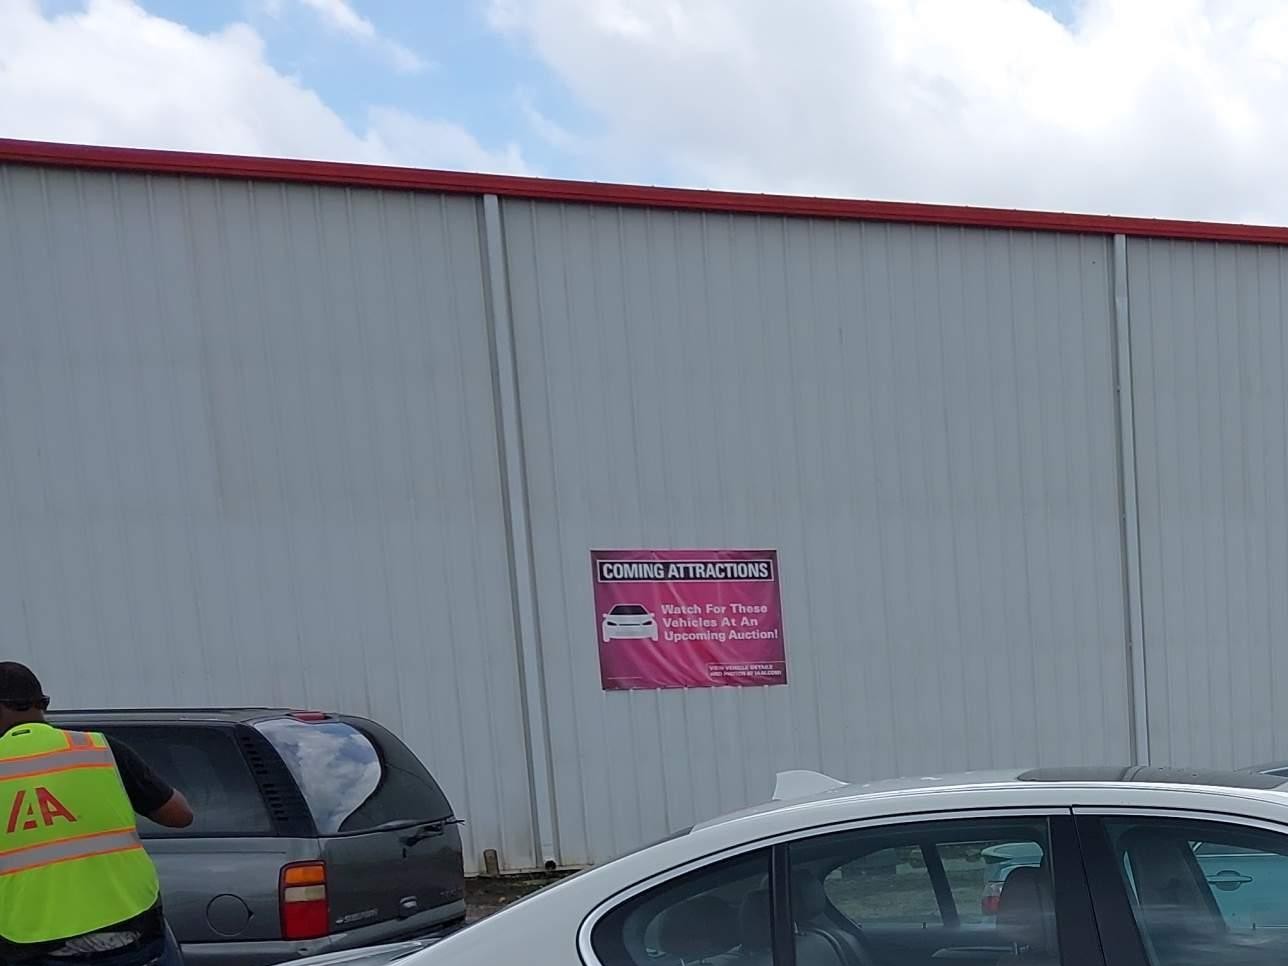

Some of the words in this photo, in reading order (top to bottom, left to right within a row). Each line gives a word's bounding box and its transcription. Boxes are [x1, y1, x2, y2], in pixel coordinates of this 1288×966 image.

[602, 563, 665, 579] COMING
[668, 562, 769, 579] ATTRACTIONS
[660, 604, 702, 615] Watch
[706, 603, 727, 614] For
[731, 603, 768, 614] These
[662, 617, 717, 628] Vehicles
[723, 617, 737, 627] At
[741, 617, 758, 627] An
[663, 630, 726, 643] Upcoming
[728, 629, 778, 640] Auction!
